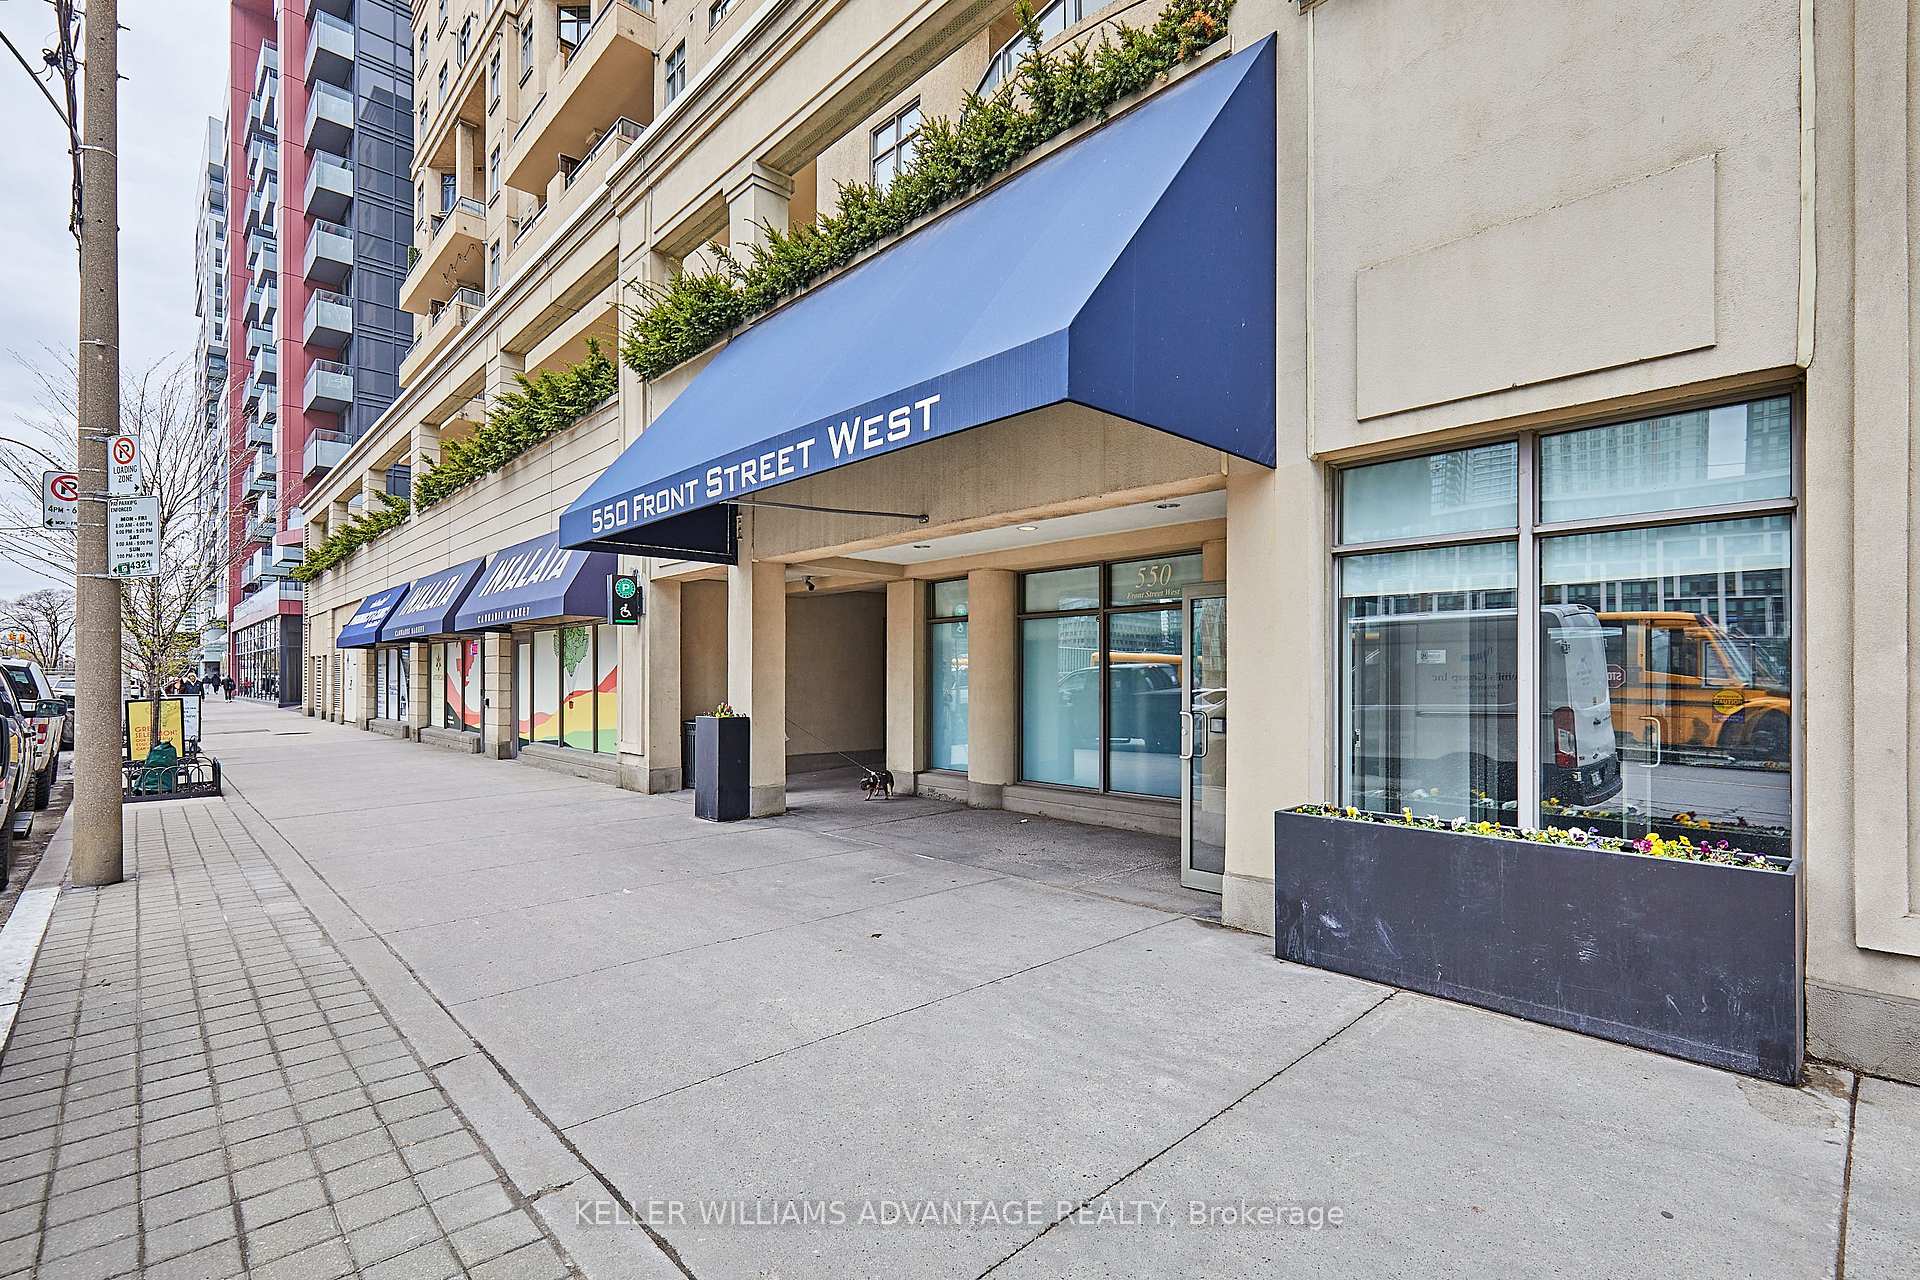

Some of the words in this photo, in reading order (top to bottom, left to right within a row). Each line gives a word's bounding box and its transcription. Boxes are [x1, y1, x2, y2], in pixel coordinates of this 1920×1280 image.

[592, 499, 628, 534] 550
[633, 478, 699, 522] FRONT
[706, 437, 816, 499] STREET
[827, 393, 941, 460] WEST
[113, 464, 138, 475] LOADING
[118, 474, 133, 483] ZONE
[48, 505, 64, 514] 4PM
[130, 560, 151, 570] 4321
[1135, 564, 1172, 588] 550
[622, 583, 630, 592] P
[1127, 592, 1145, 600] Front
[1145, 590, 1164, 598] Street
[1165, 588, 1180, 596] West
[477, 611, 504, 624] CANNABIS
[506, 606, 530, 619] MARKET
